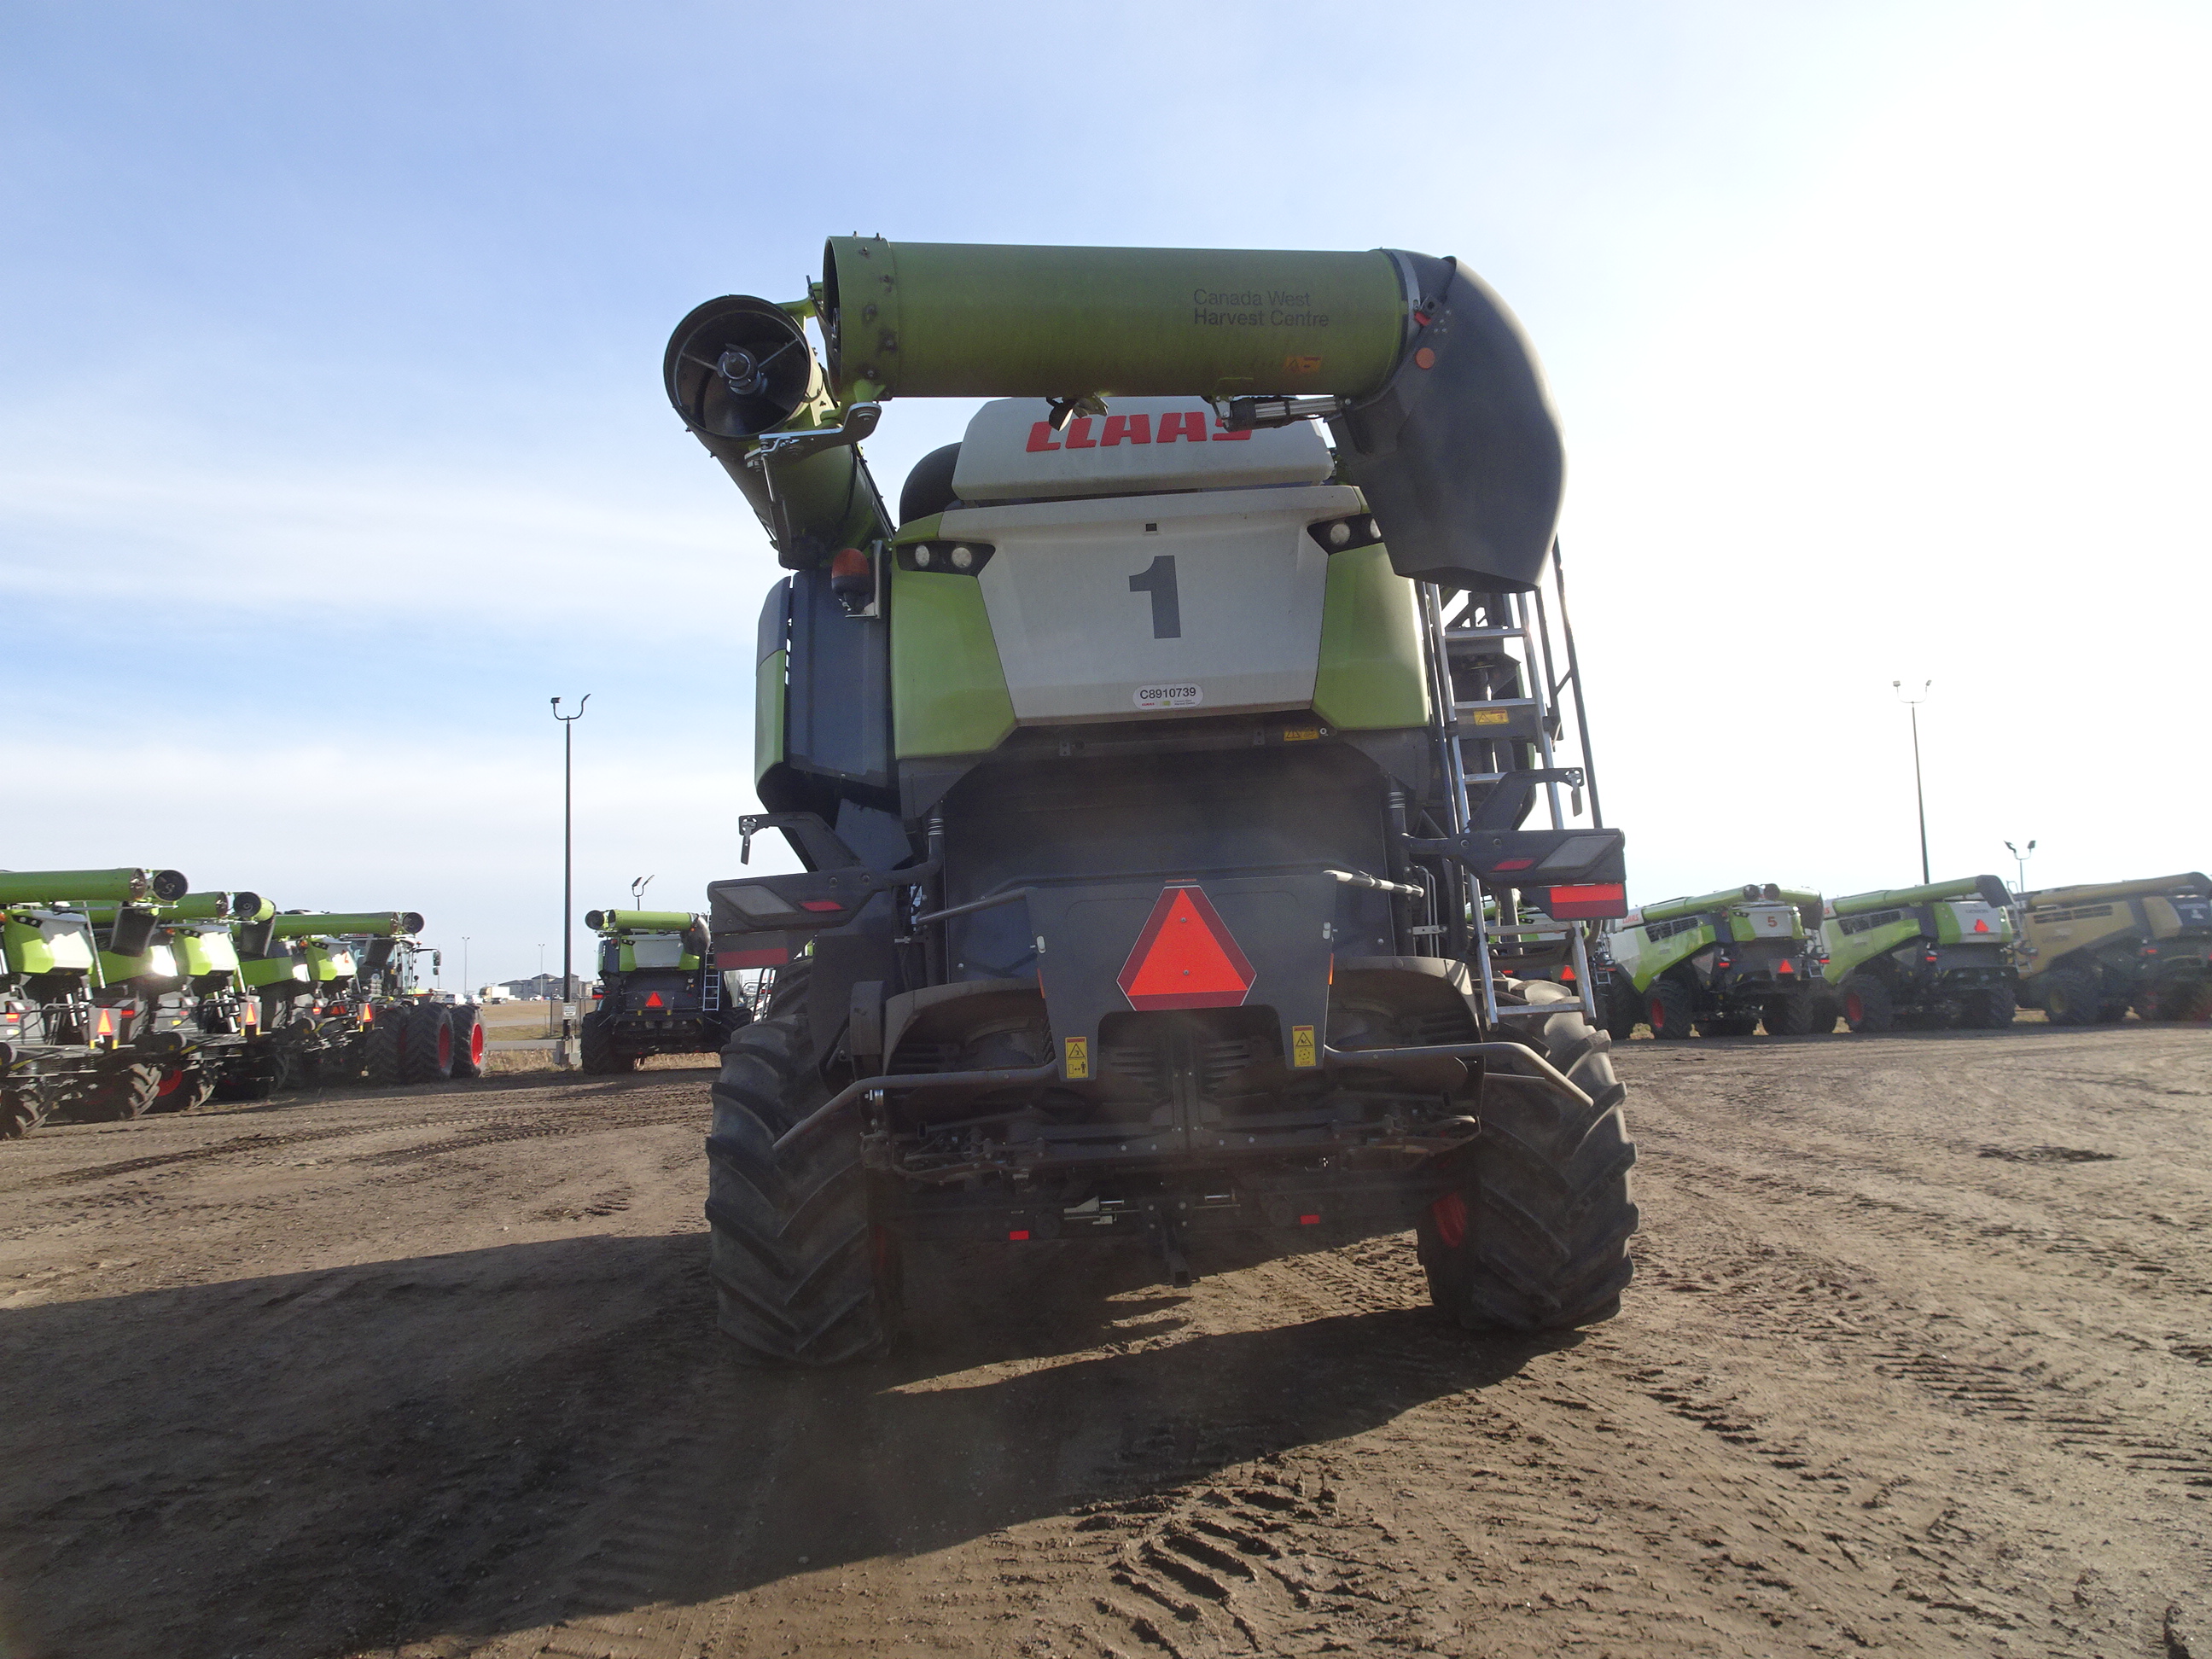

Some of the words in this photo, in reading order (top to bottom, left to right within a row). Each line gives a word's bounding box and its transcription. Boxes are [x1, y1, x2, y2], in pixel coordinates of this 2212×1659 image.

[1194, 288, 1263, 306] Canada
[1268, 290, 1311, 306] West
[1195, 307, 1265, 326] Harvest
[1270, 310, 1330, 327] Centre
[1128, 555, 1182, 639] 1
[1139, 687, 1196, 700] C8910739
[1767, 916, 1778, 928] 5
